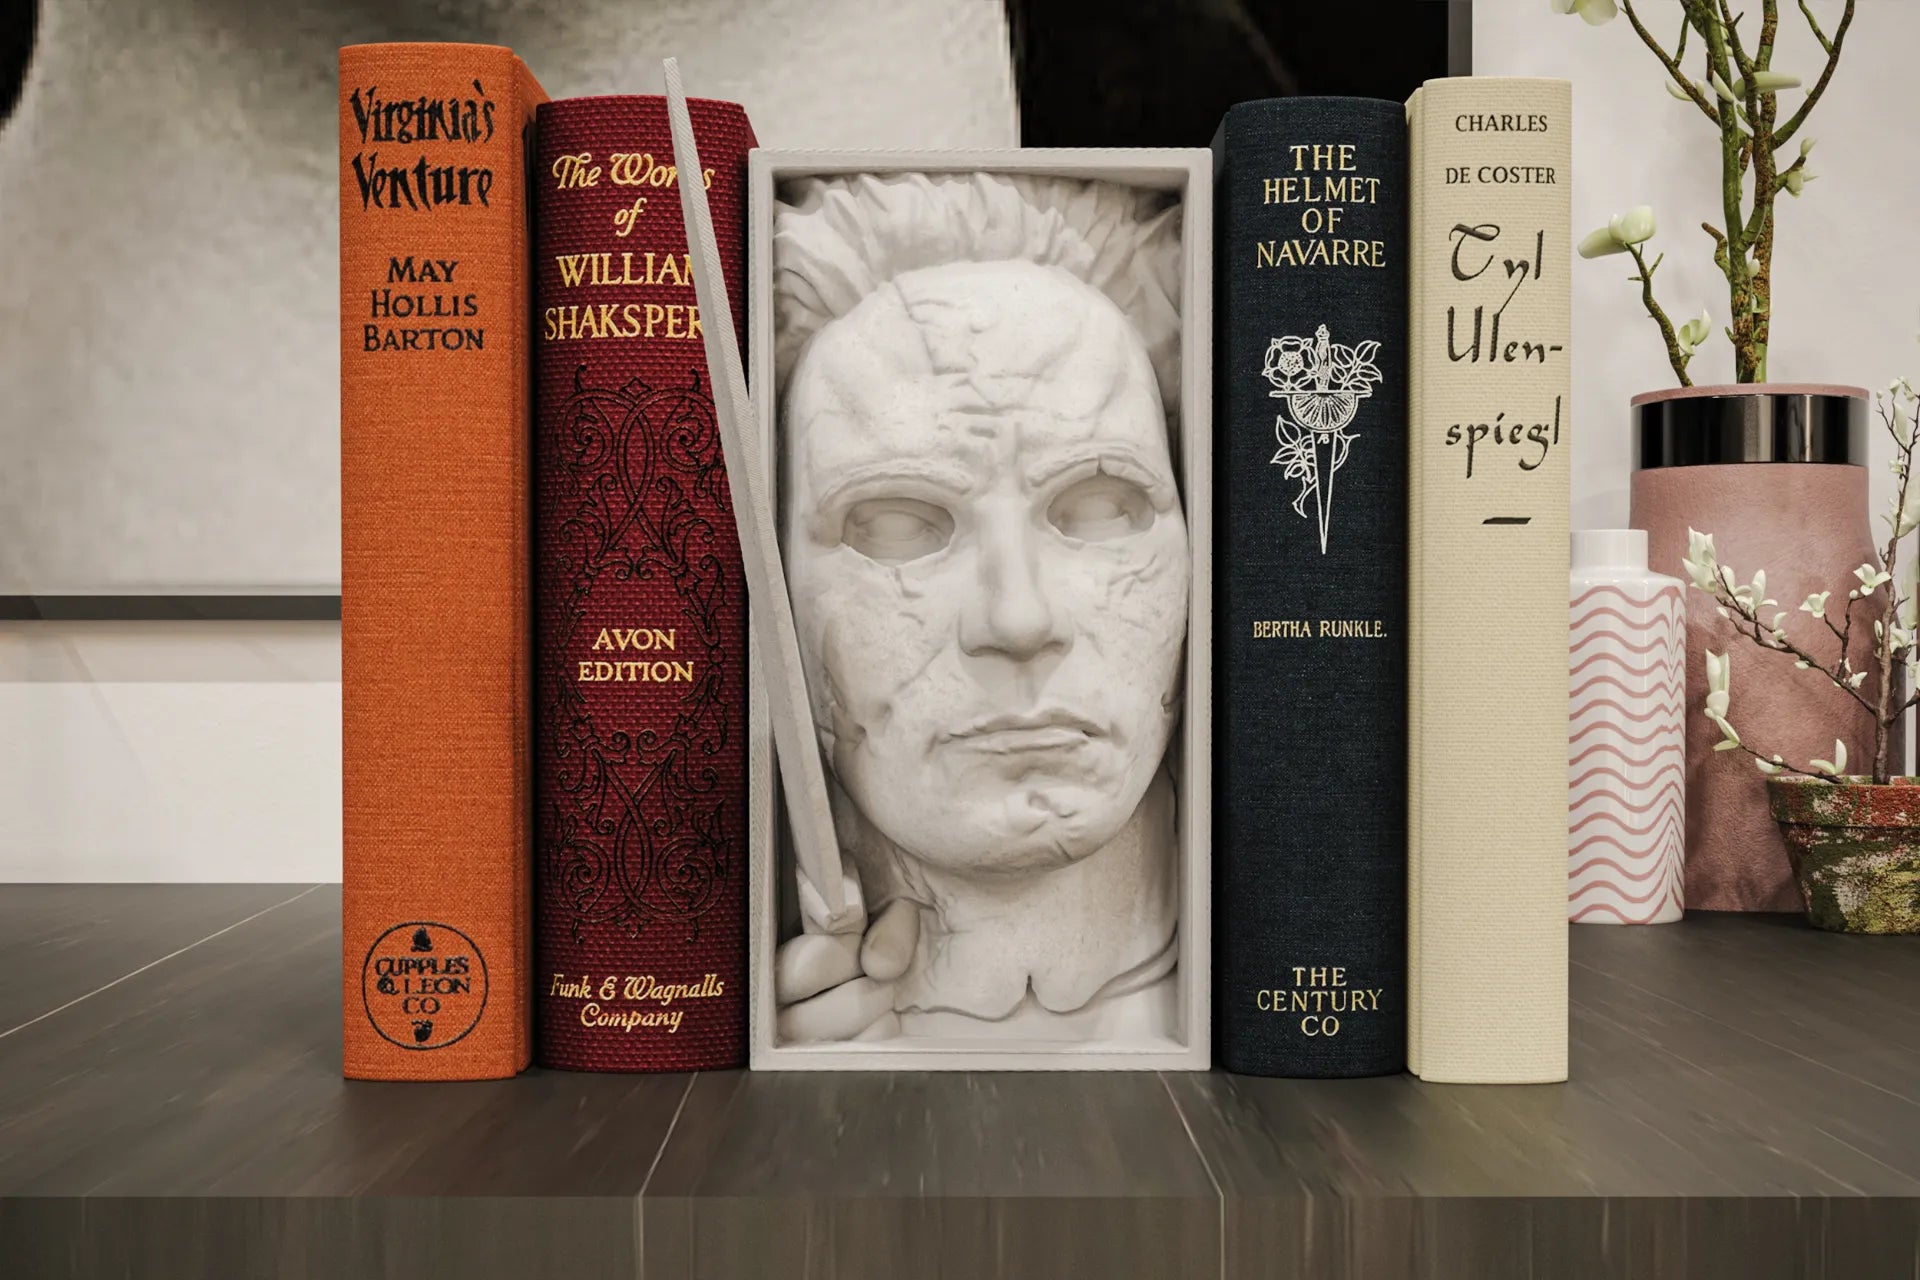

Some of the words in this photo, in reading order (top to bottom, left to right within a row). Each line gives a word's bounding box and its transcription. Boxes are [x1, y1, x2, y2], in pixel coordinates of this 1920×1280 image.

[350, 78, 496, 144] Virginia's
[1455, 114, 1548, 133] CHARLES
[552, 152, 602, 189] The
[609, 152, 716, 190] Wors
[1289, 144, 1357, 171] THE
[351, 152, 493, 212] Venture
[1445, 167, 1471, 185] DE
[1477, 166, 1556, 185] COSTER
[1263, 177, 1381, 205] HELMET
[613, 197, 648, 237] of
[1301, 207, 1344, 233] OF
[1256, 239, 1386, 268] NAVARRE
[387, 256, 459, 283] MAY
[1449, 223, 1544, 314] Tyl
[371, 288, 478, 318] HOLLIS
[545, 303, 705, 340] SHAKSPER
[363, 324, 484, 352] BARTON
[1445, 395, 1561, 479] spiegl
[591, 627, 676, 651] AVON
[1253, 620, 1312, 638] BERTHA
[1319, 620, 1388, 638] RUNKLE.
[577, 661, 694, 683] EDITION
[375, 956, 469, 976] CUPPLES
[1292, 967, 1347, 987] THE
[404, 977, 471, 994] LEON
[550, 973, 591, 999] Funk
[624, 973, 725, 1006] Wagnalls
[402, 997, 441, 1015] CO
[1256, 989, 1383, 1012] CENTURY
[580, 1002, 684, 1034] Company
[1300, 1015, 1340, 1037] CO
